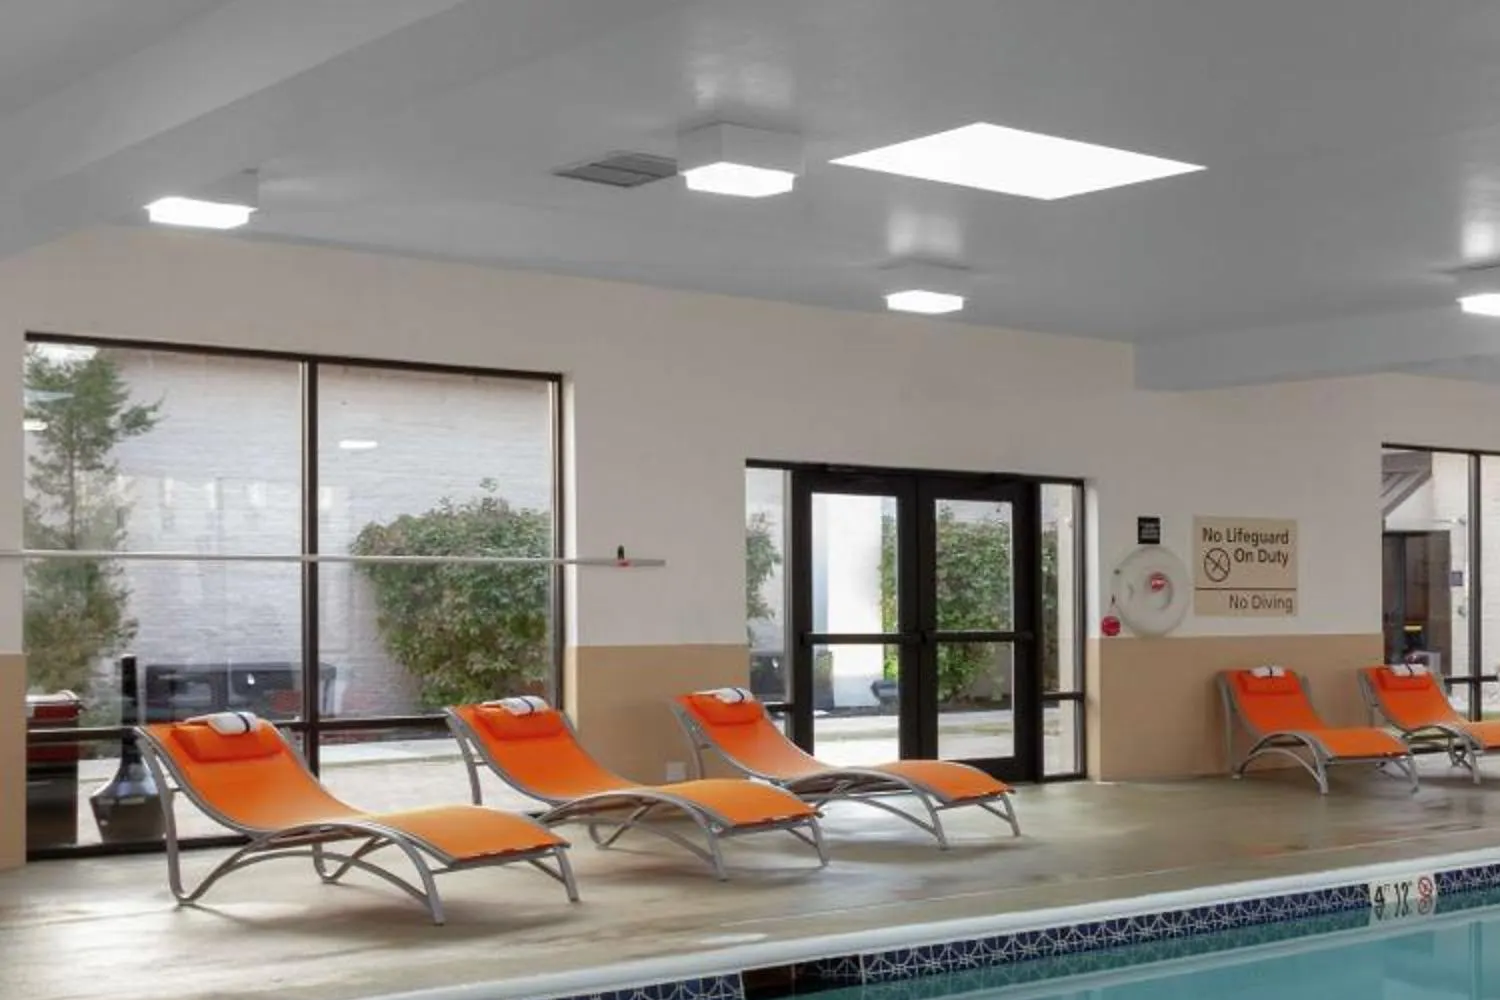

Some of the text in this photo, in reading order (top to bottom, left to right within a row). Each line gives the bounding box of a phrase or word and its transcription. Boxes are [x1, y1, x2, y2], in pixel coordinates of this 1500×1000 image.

[1202, 528, 1290, 547] No Lifeguard
[1234, 548, 1289, 567] On Duty
[1229, 594, 1294, 614] No Diving
